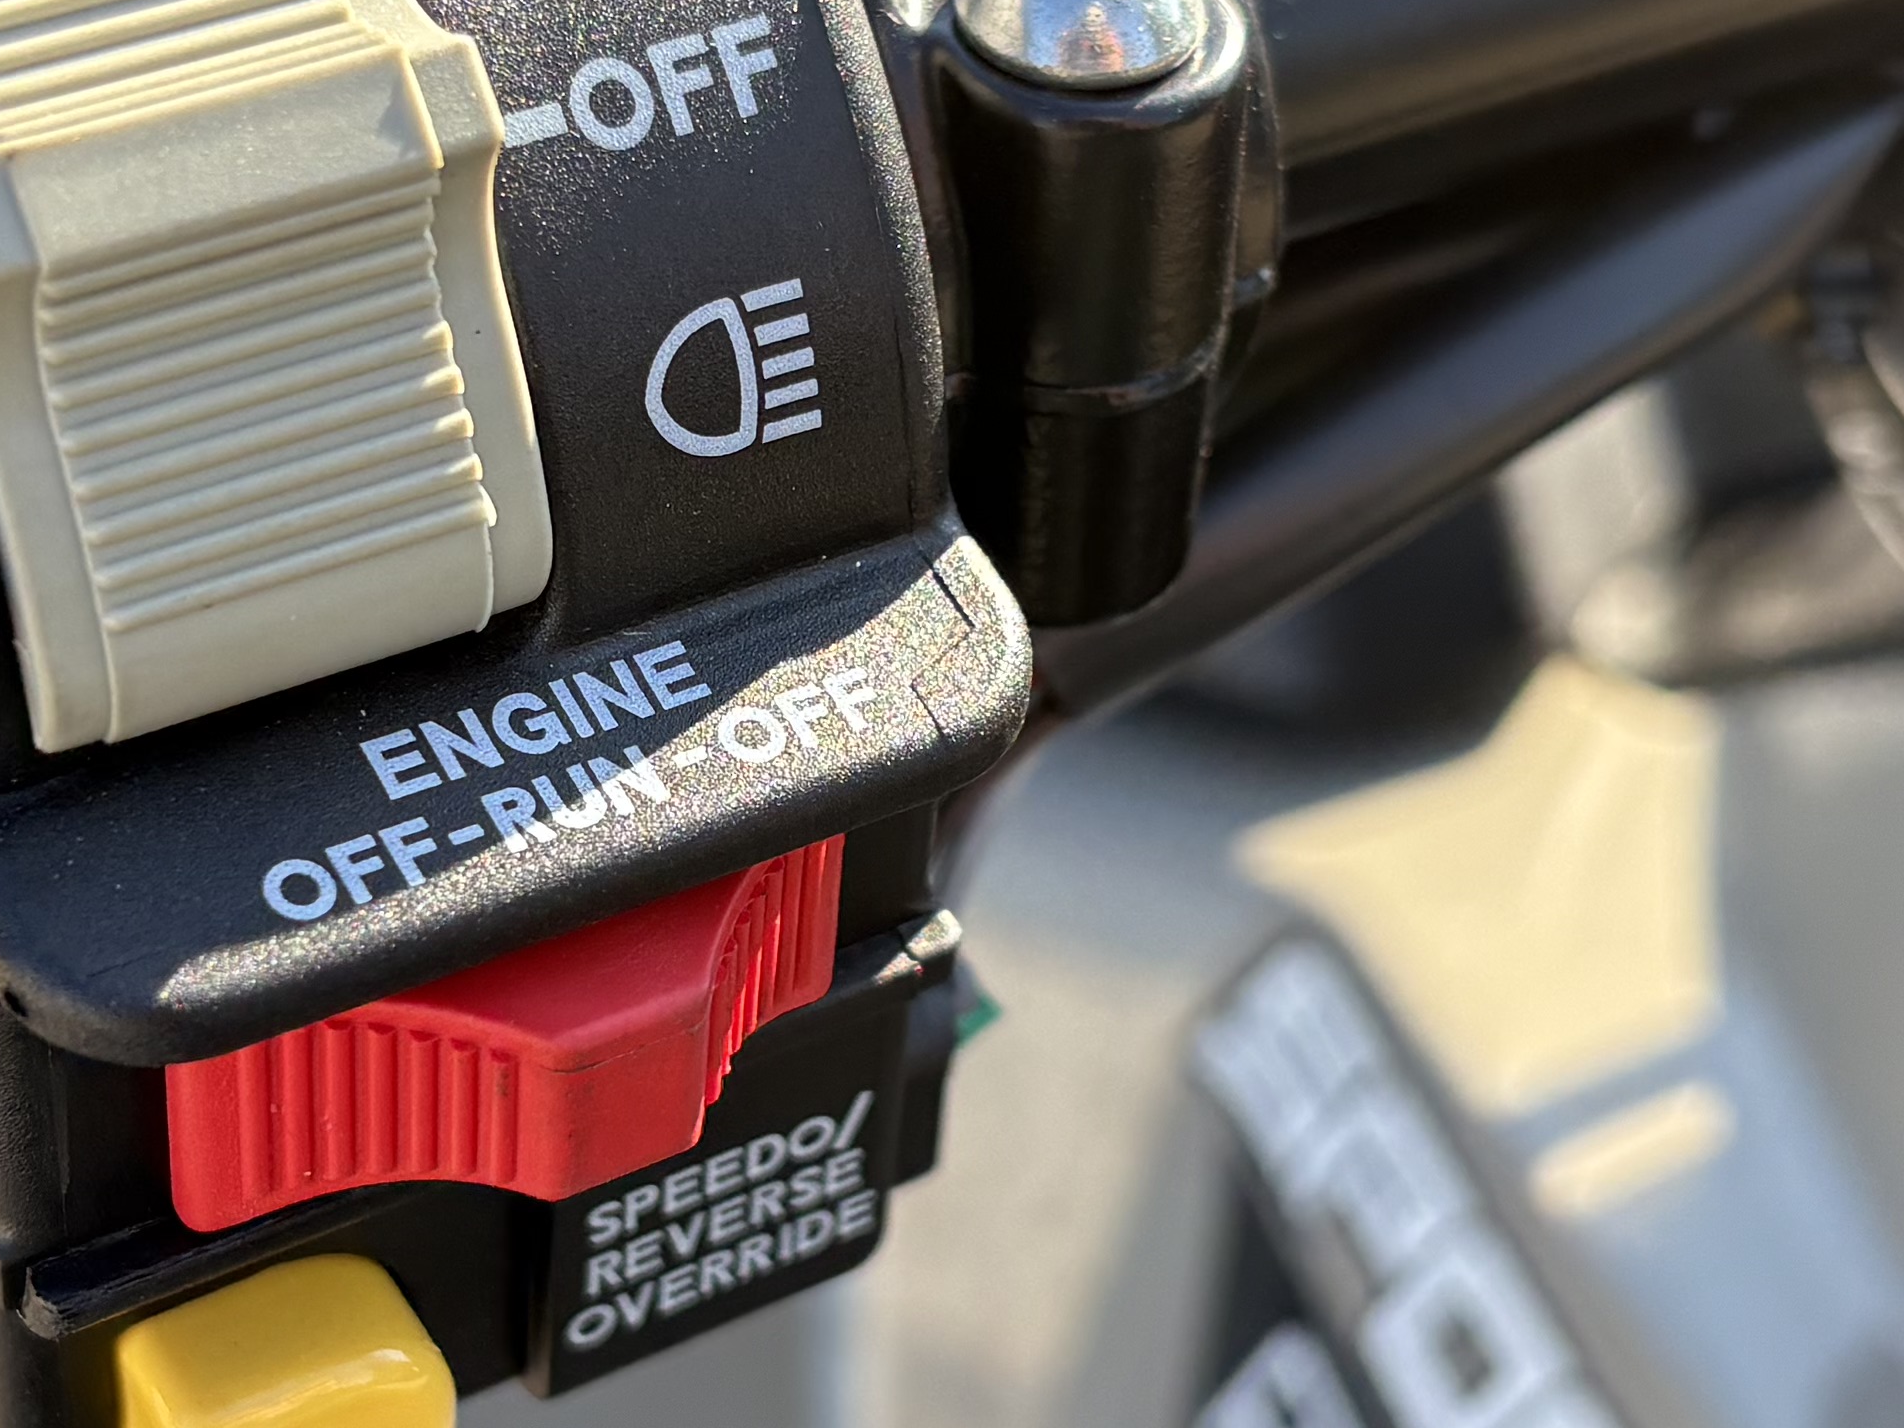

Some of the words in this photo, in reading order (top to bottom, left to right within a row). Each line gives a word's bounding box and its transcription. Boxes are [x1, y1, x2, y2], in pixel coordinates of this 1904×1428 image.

[359, 639, 712, 801] ENGINE
[584, 1148, 865, 1298] REVERSE
[585, 1089, 875, 1247] SPEEDO/
[564, 1189, 878, 1349] OVERRIDE
